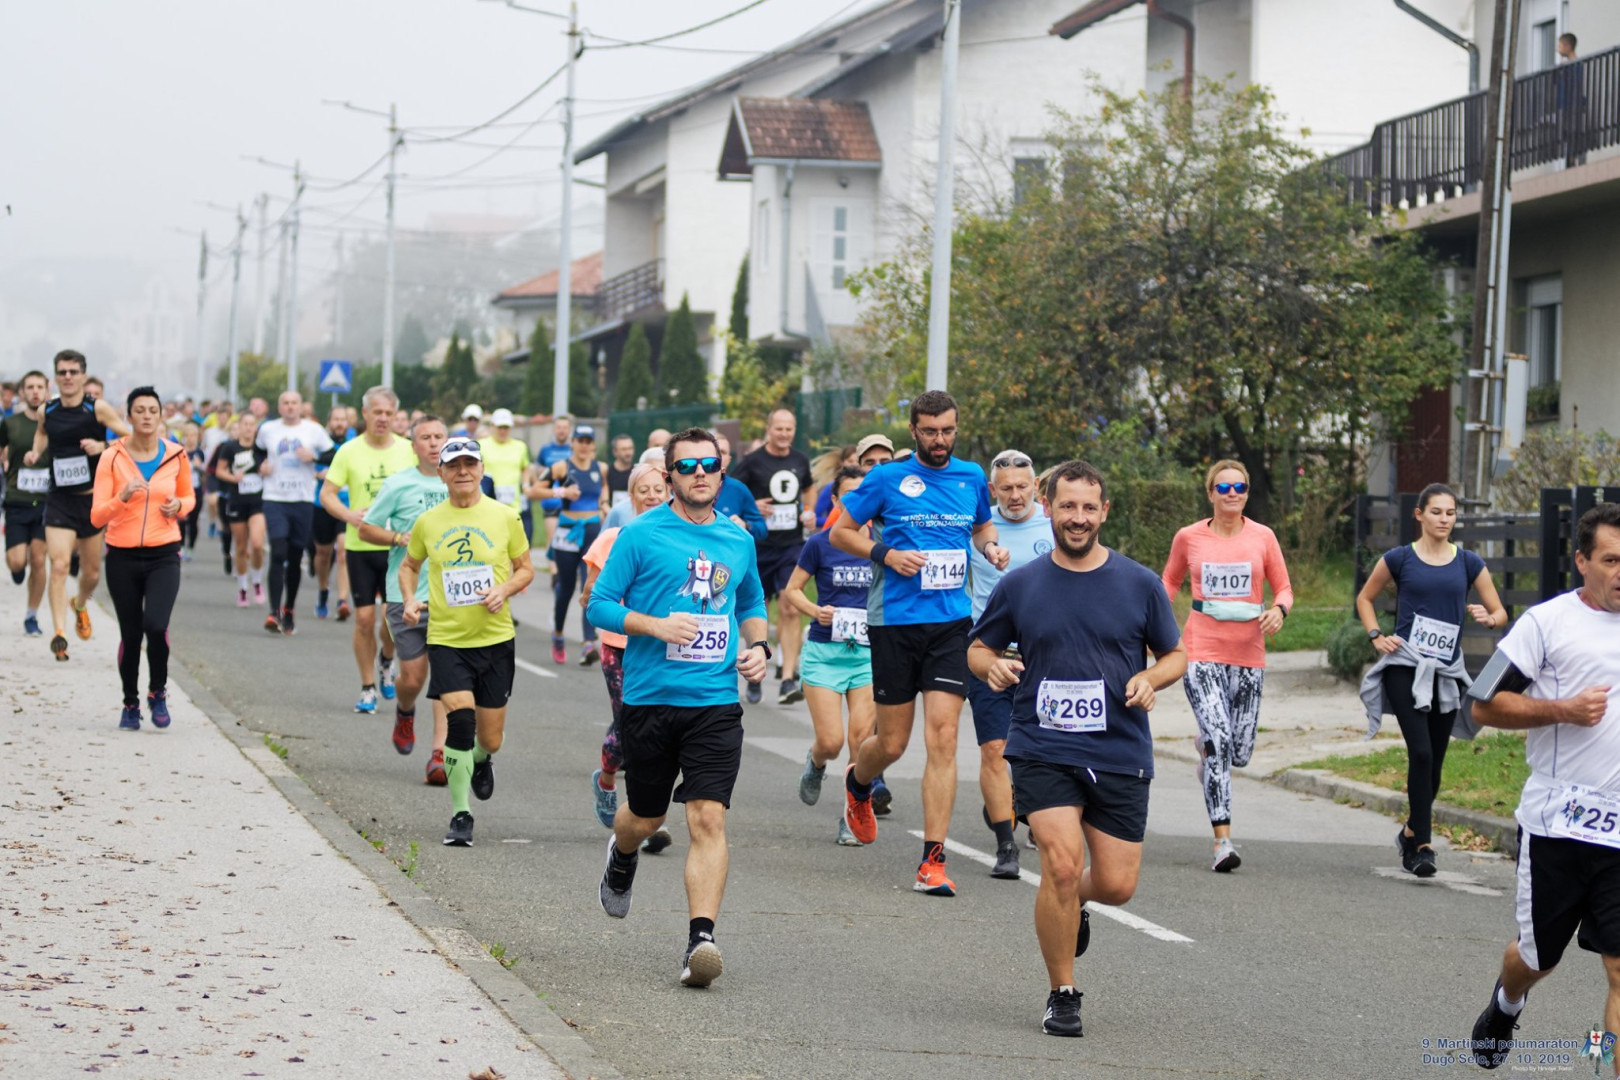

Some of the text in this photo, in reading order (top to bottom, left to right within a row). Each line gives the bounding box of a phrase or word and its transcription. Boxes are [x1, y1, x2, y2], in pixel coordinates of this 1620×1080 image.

[940, 563, 965, 579] 144
[462, 578, 491, 596] 081
[1220, 574, 1250, 589] 107
[851, 622, 869, 636] 13
[691, 630, 727, 650] 258
[1427, 632, 1455, 652] 064
[1060, 697, 1103, 719] 269
[1582, 808, 1620, 834] 25
